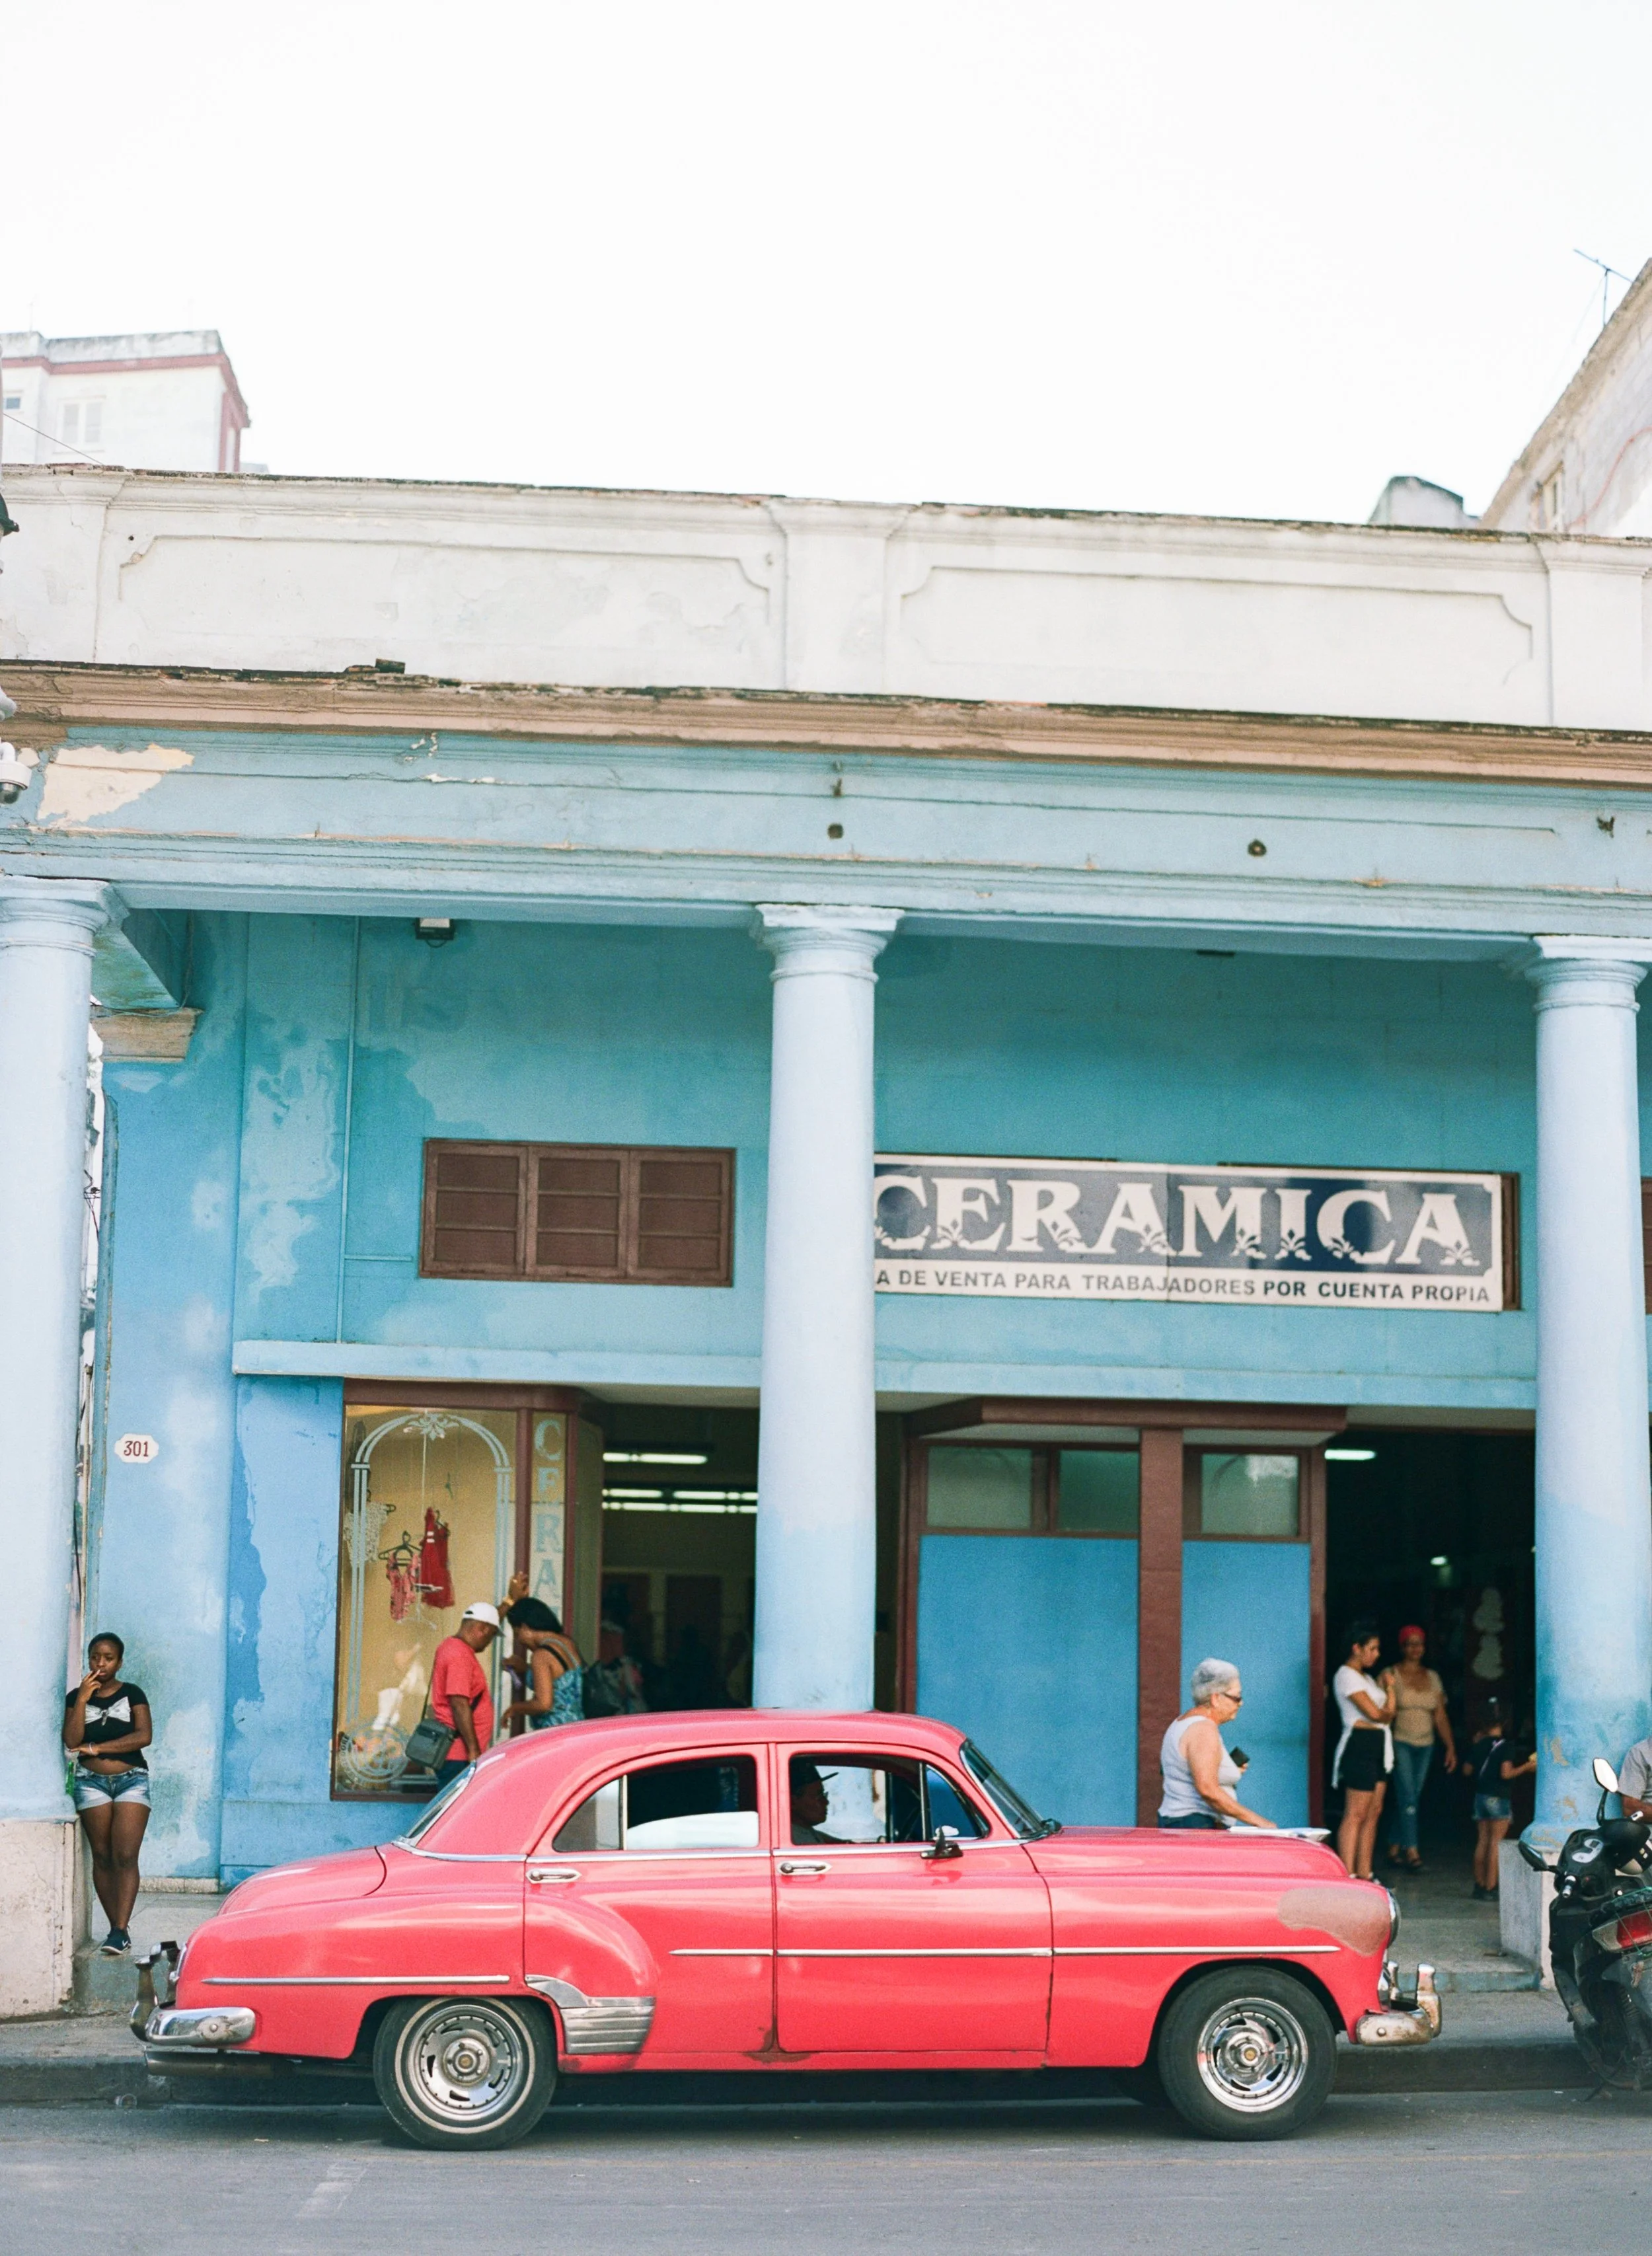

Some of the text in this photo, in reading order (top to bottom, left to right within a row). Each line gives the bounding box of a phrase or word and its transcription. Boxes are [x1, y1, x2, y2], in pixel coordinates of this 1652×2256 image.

[874, 1174, 1481, 1266] CERAMICA
[899, 1270, 926, 1285] DE
[934, 1271, 1006, 1288] VENTA
[1014, 1273, 1071, 1291] PARA
[1082, 1274, 1256, 1296] TRABAJADORES
[1263, 1281, 1306, 1297] POR
[1318, 1282, 1404, 1300] CUENTA
[1411, 1284, 1489, 1302] PROPIA
[124, 1441, 149, 1457] 301
